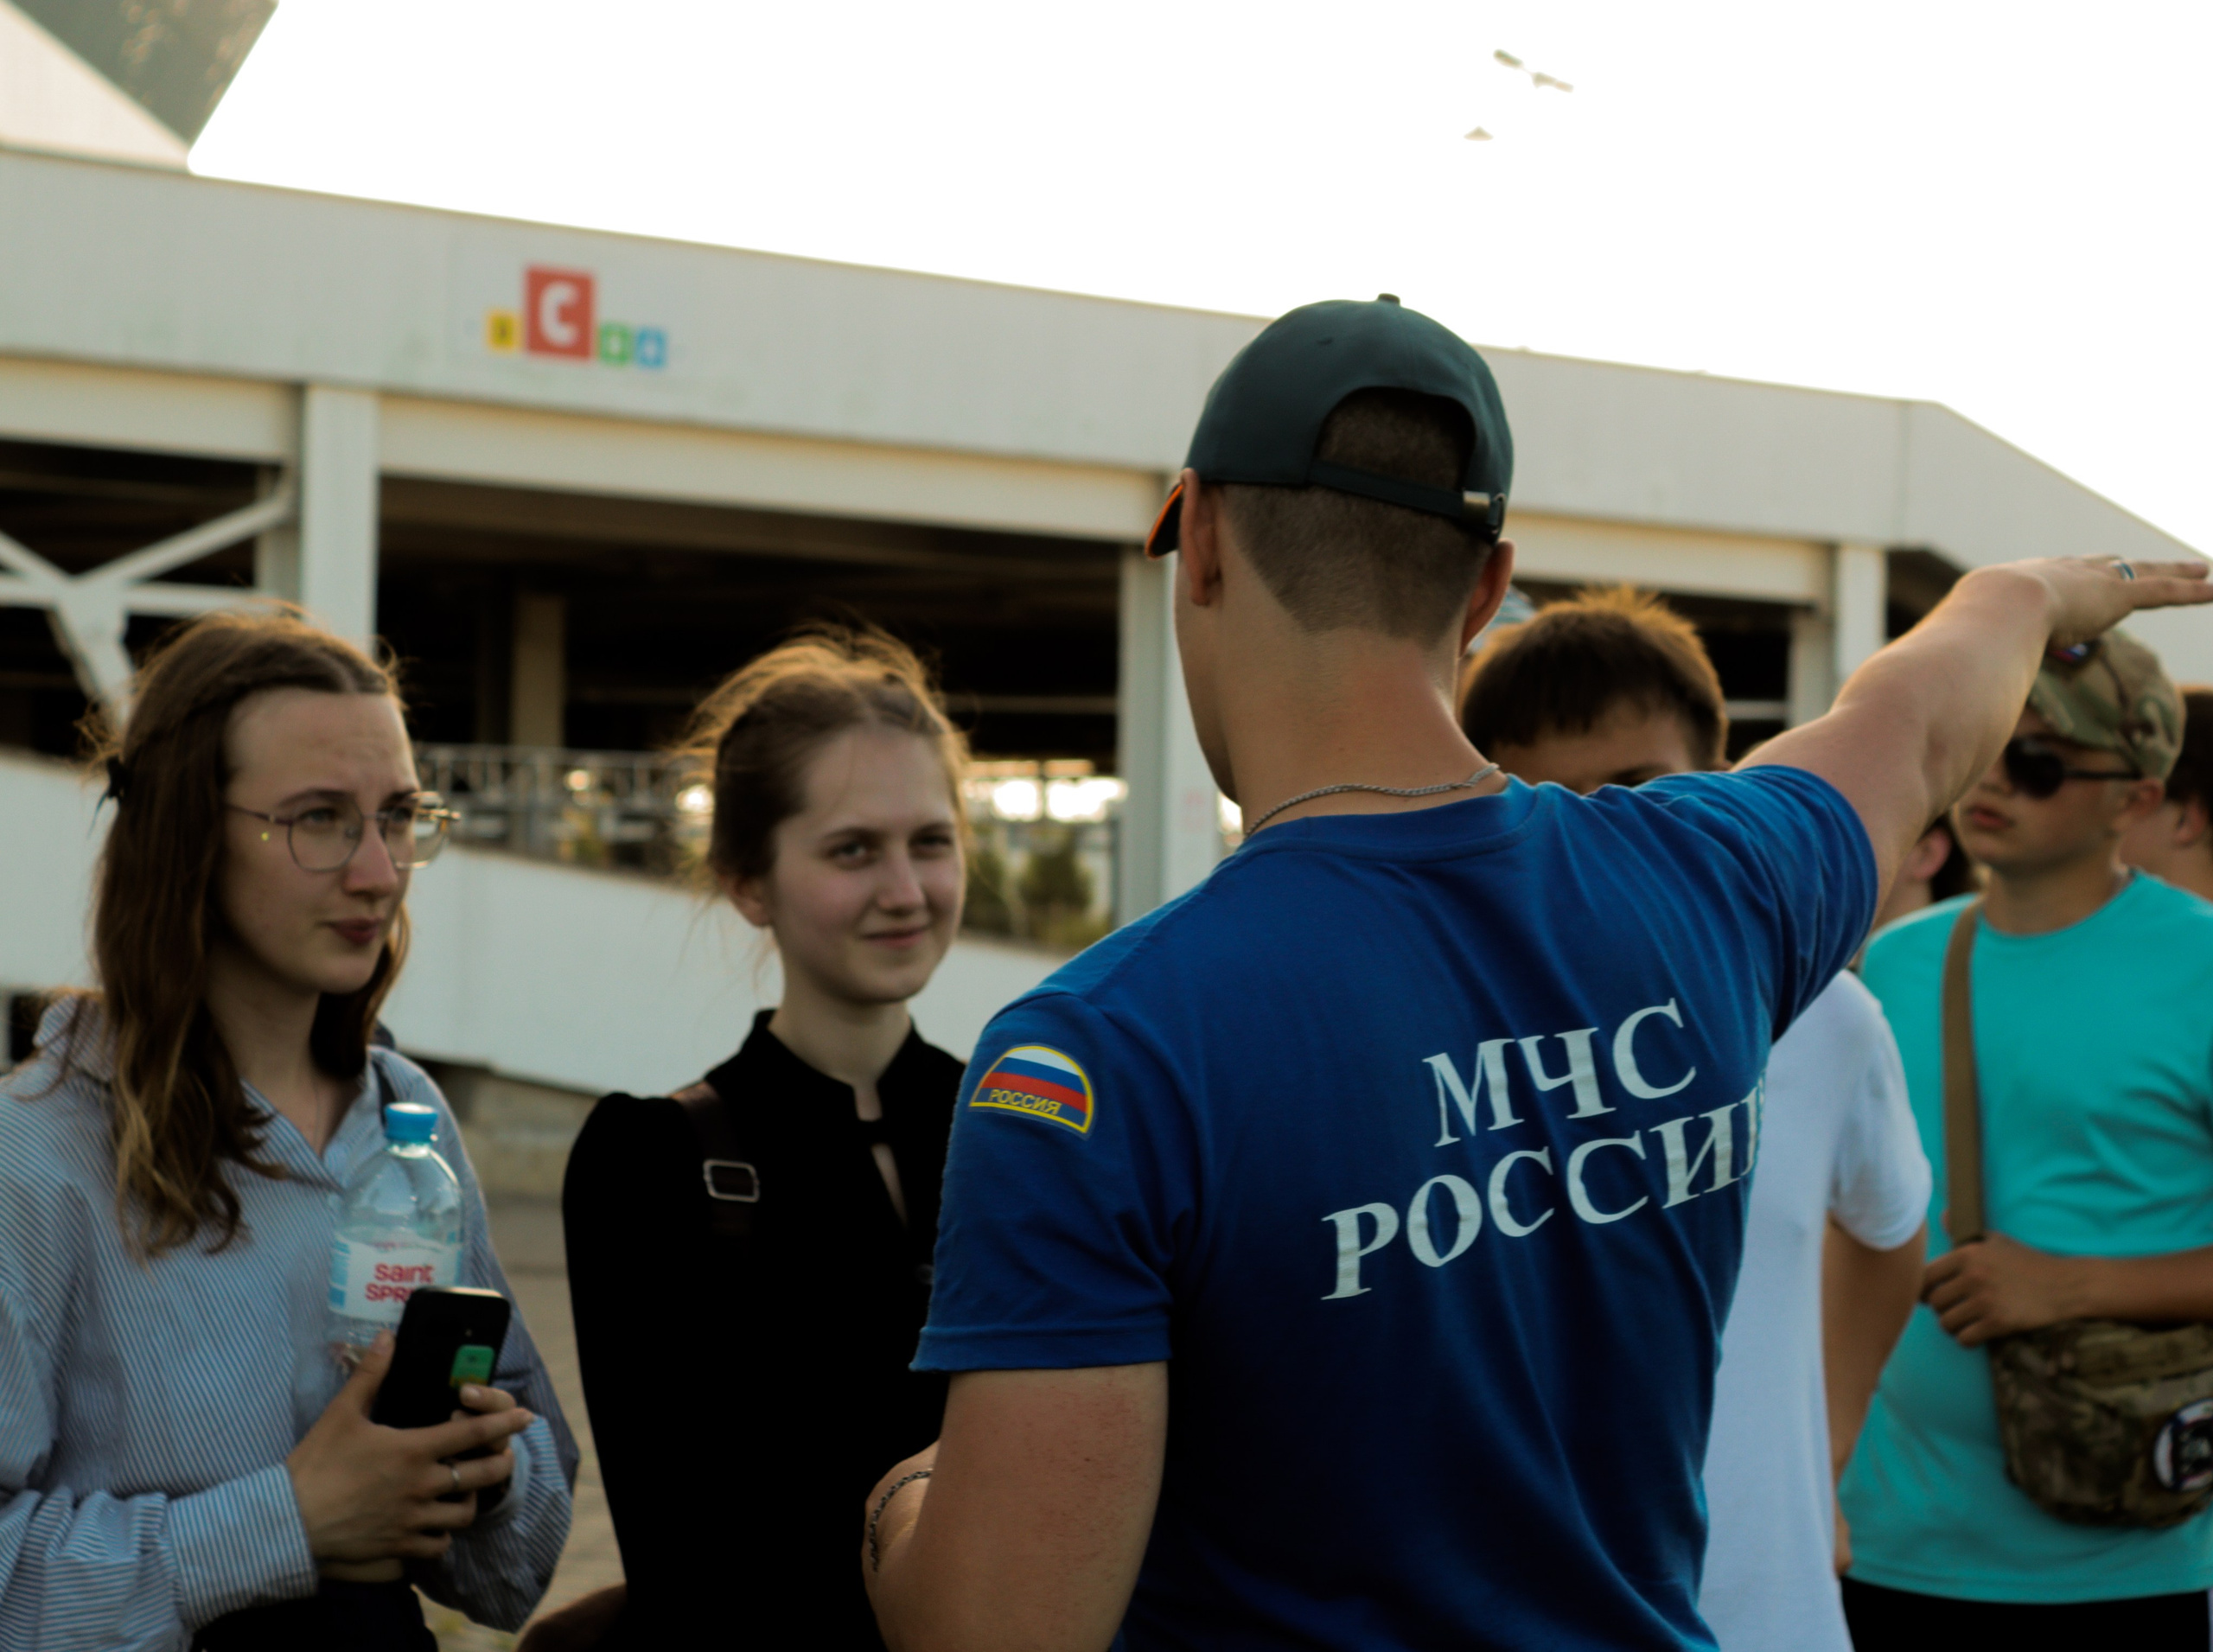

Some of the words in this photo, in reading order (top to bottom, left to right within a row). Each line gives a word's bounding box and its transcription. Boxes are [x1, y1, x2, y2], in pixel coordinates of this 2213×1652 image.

[1422, 997, 1697, 1148] МЧС
[989, 1088, 1062, 1115] РОССИЯ
[366, 1283, 412, 1302] SPR
